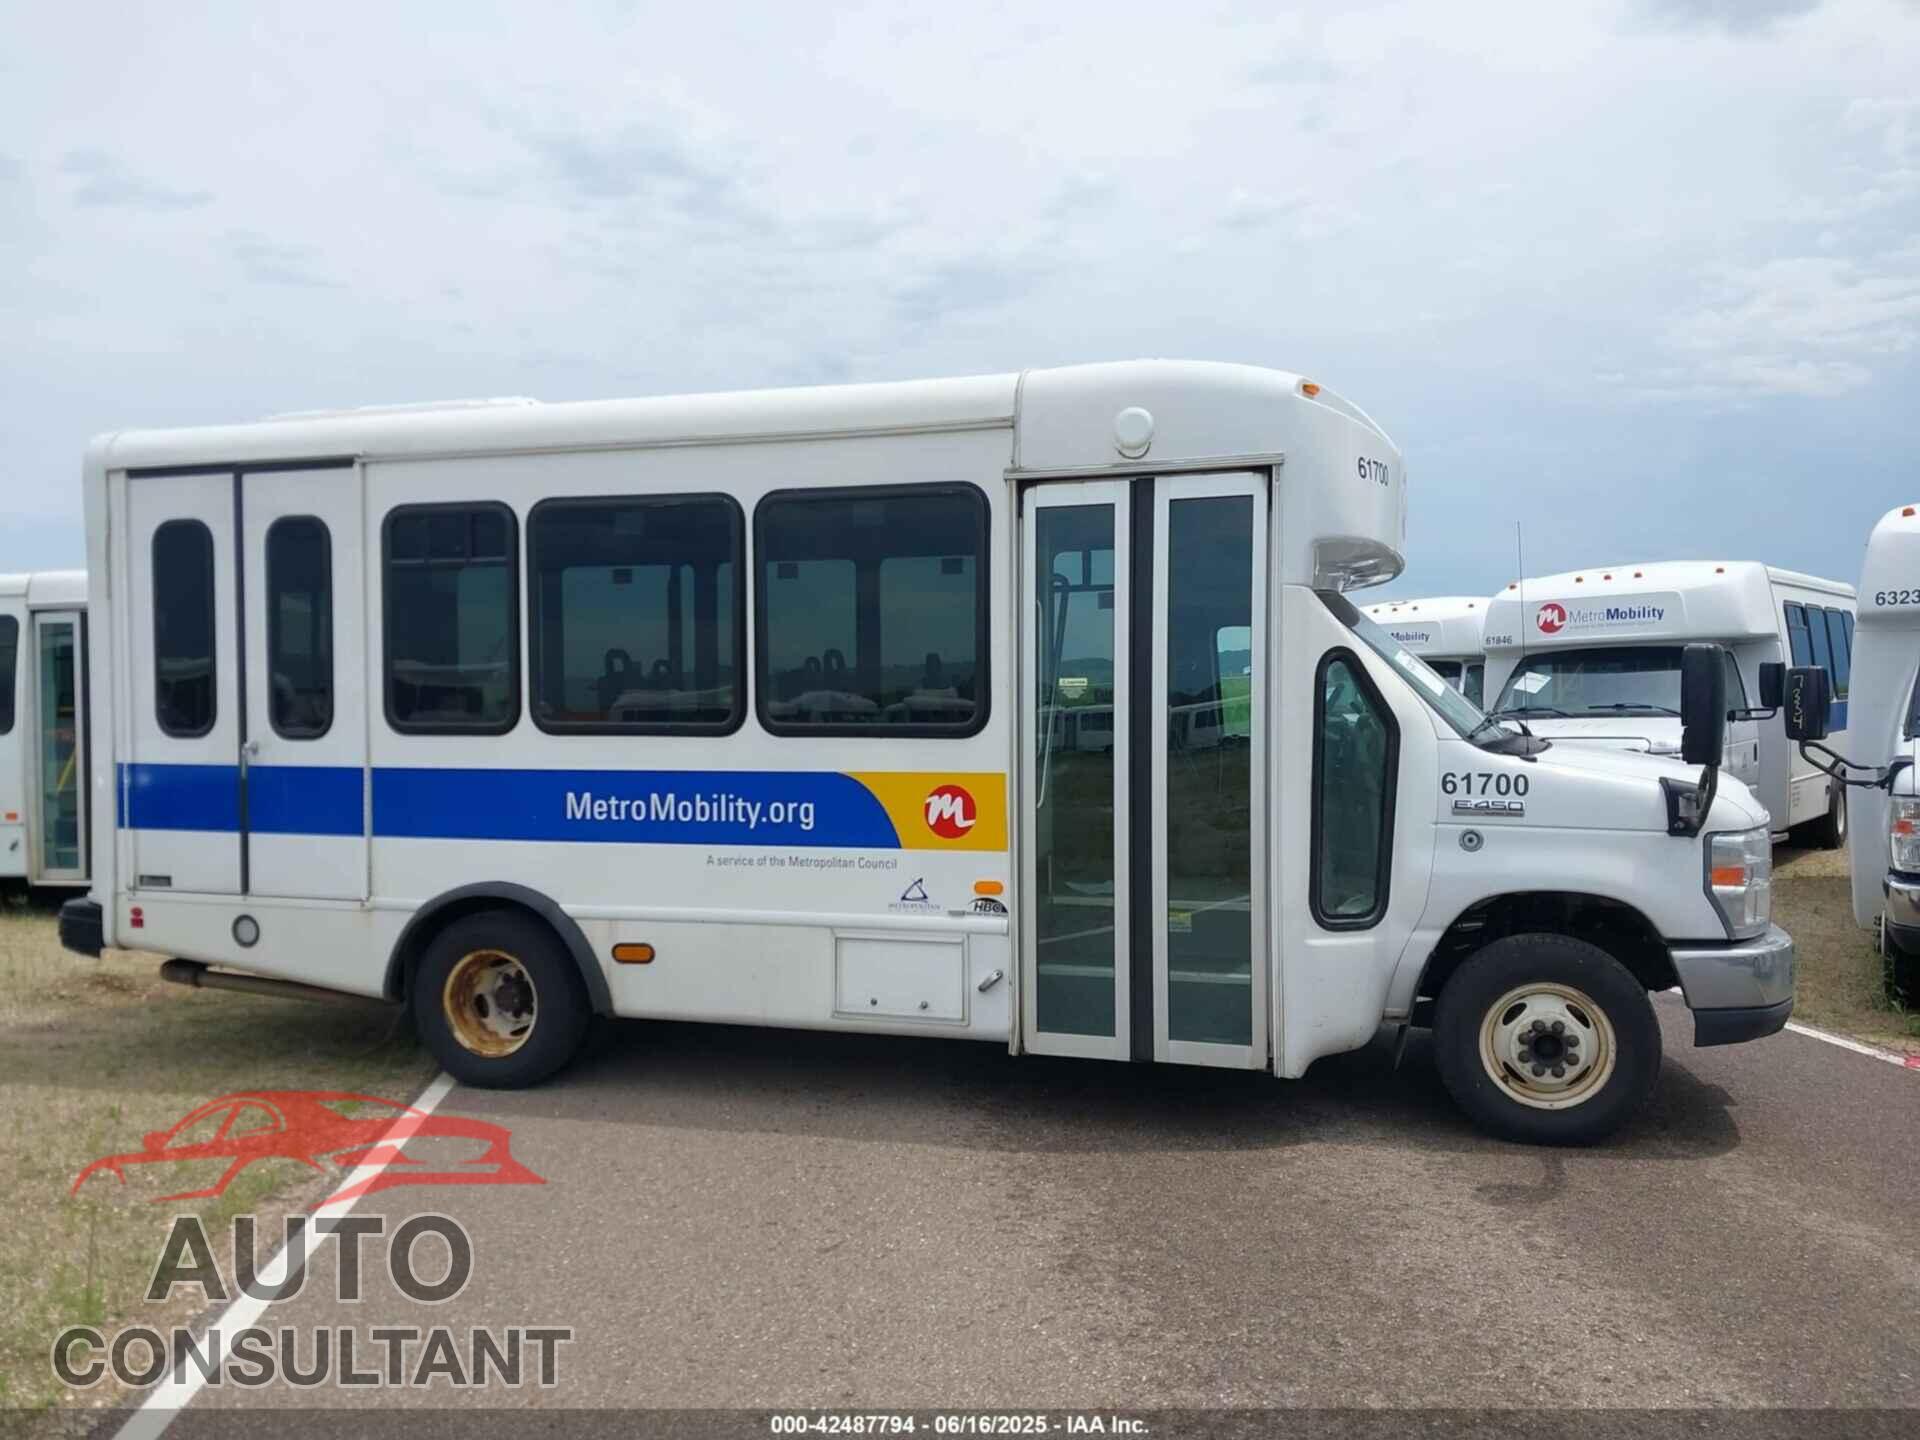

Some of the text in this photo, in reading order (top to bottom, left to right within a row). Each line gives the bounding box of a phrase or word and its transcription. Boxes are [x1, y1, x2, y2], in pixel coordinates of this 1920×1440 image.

[1358, 457, 1389, 486] 61700
[1875, 589, 1920, 606] 6323
[1568, 605, 1664, 624] MetroMobility
[1441, 772, 1529, 796] 61700
[565, 791, 815, 830] MetroMobility.org
[706, 855, 897, 870] A service of the Metropolitan Council
